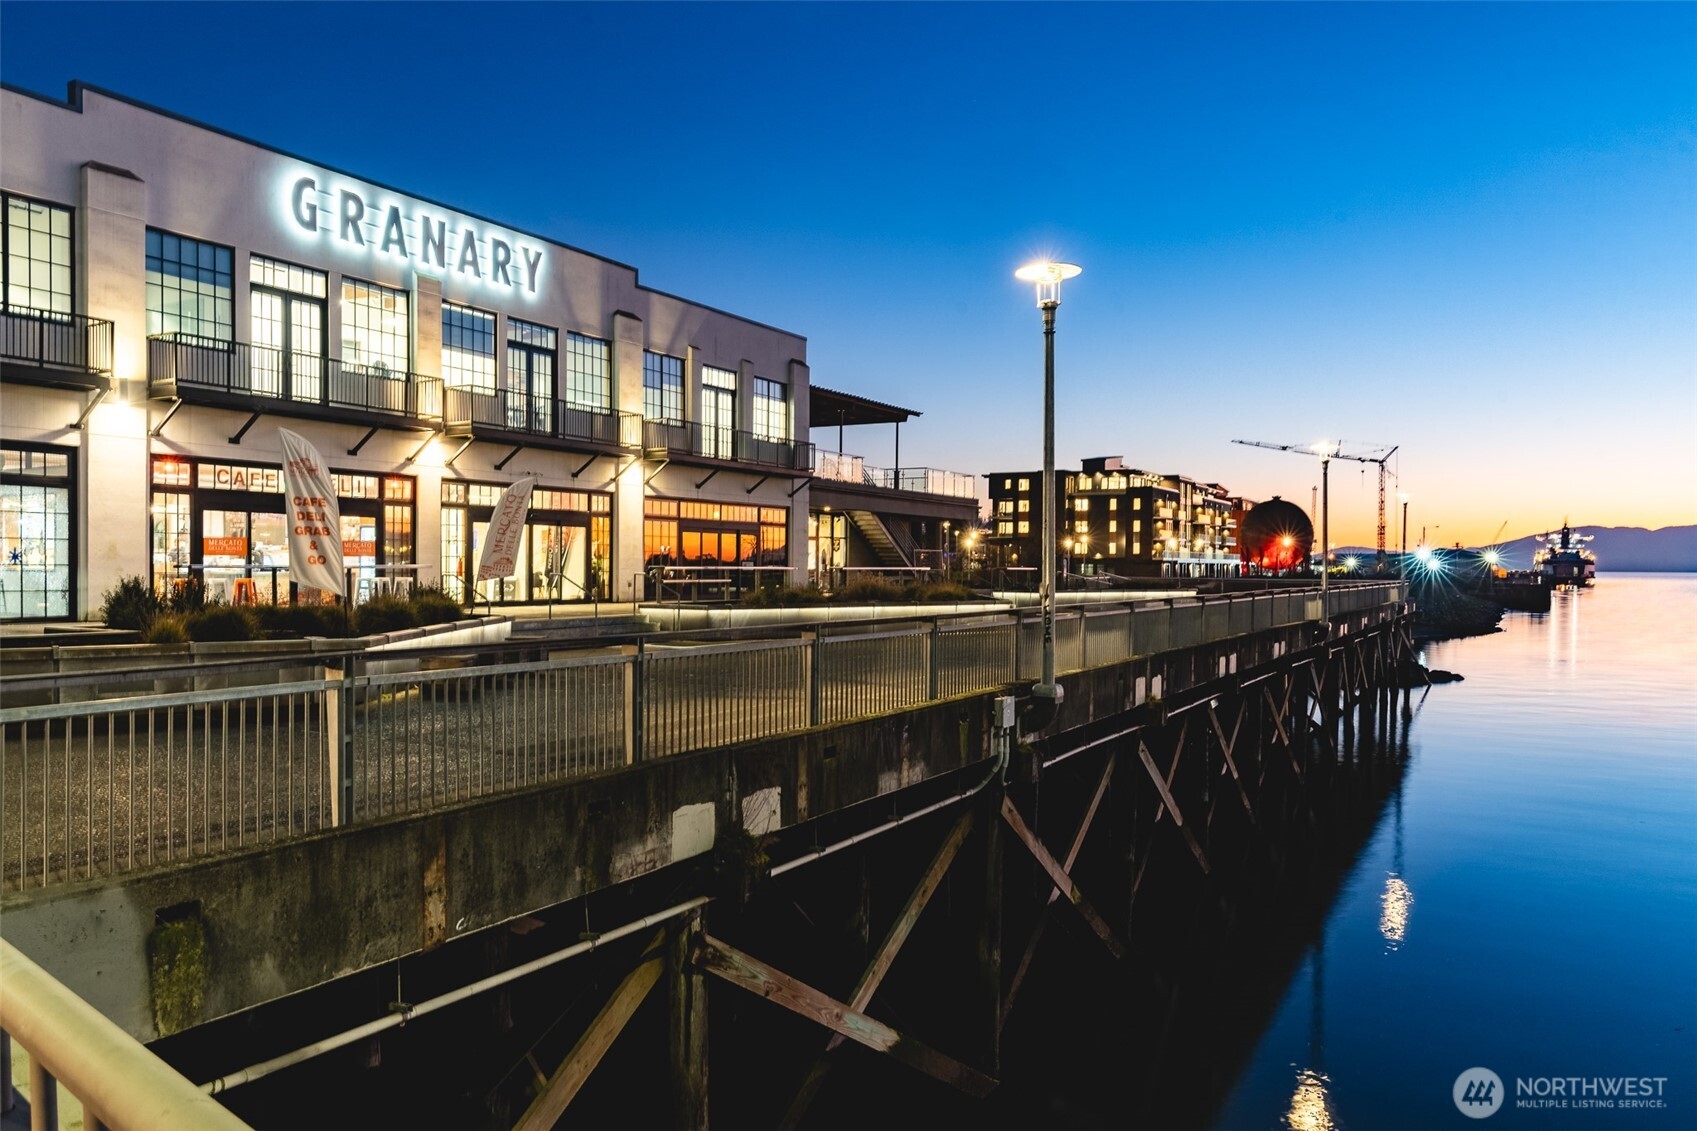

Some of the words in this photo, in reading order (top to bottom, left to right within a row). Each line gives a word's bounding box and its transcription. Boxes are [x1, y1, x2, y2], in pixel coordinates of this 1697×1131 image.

[291, 176, 543, 293] GRANARY
[216, 468, 277, 488] CAFE
[293, 496, 326, 508] CAFE
[296, 511, 326, 522] DELI
[493, 494, 517, 554] MERCATO
[294, 526, 331, 536] GRAB
[208, 538, 243, 547] MERCATO
[309, 540, 318, 550] &
[504, 527, 518, 556] DELLE
[307, 555, 327, 565] GO
